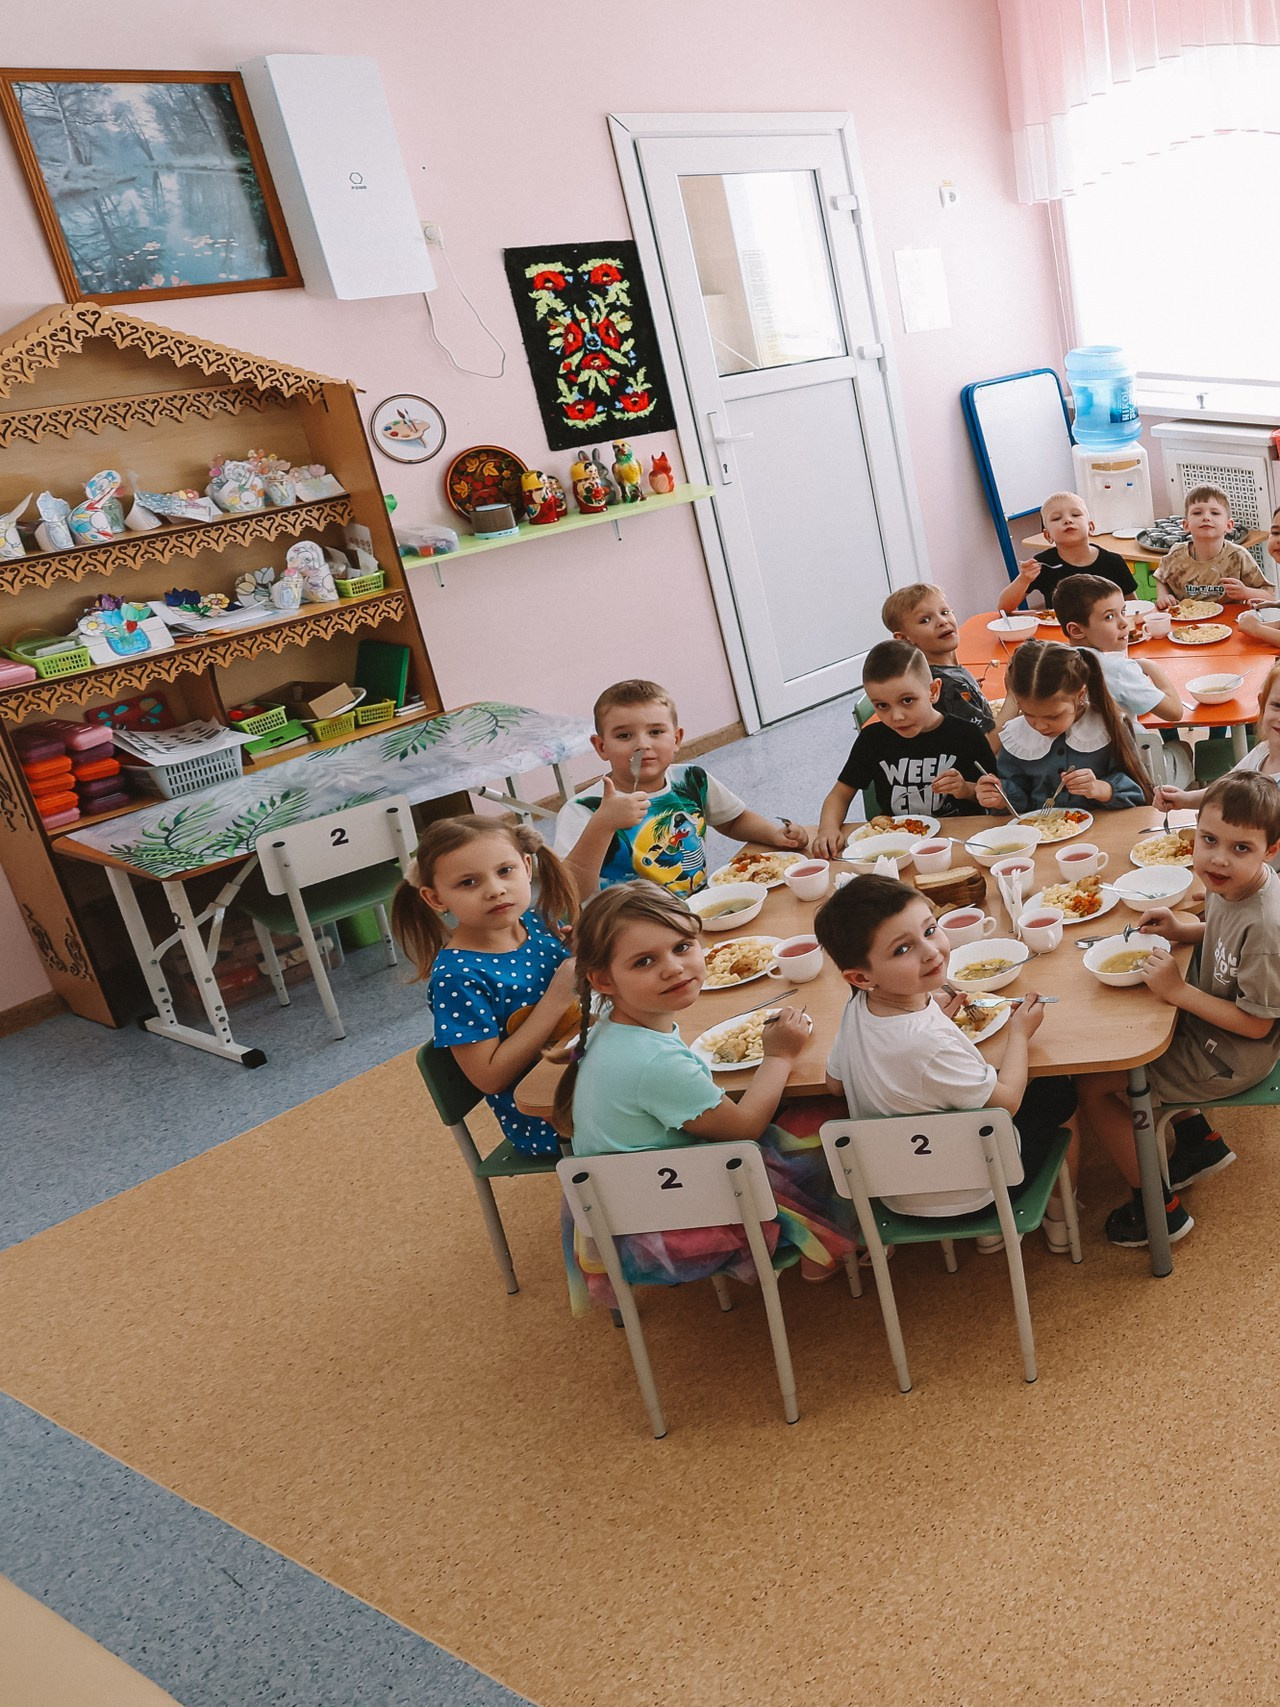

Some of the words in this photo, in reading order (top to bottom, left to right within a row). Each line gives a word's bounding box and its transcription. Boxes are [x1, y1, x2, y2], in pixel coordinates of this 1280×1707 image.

[879, 754, 957, 785] WEEK
[330, 828, 349, 846] 2
[1132, 1110, 1150, 1131] 2
[910, 1134, 932, 1155] 2
[657, 1167, 683, 1190] 2
